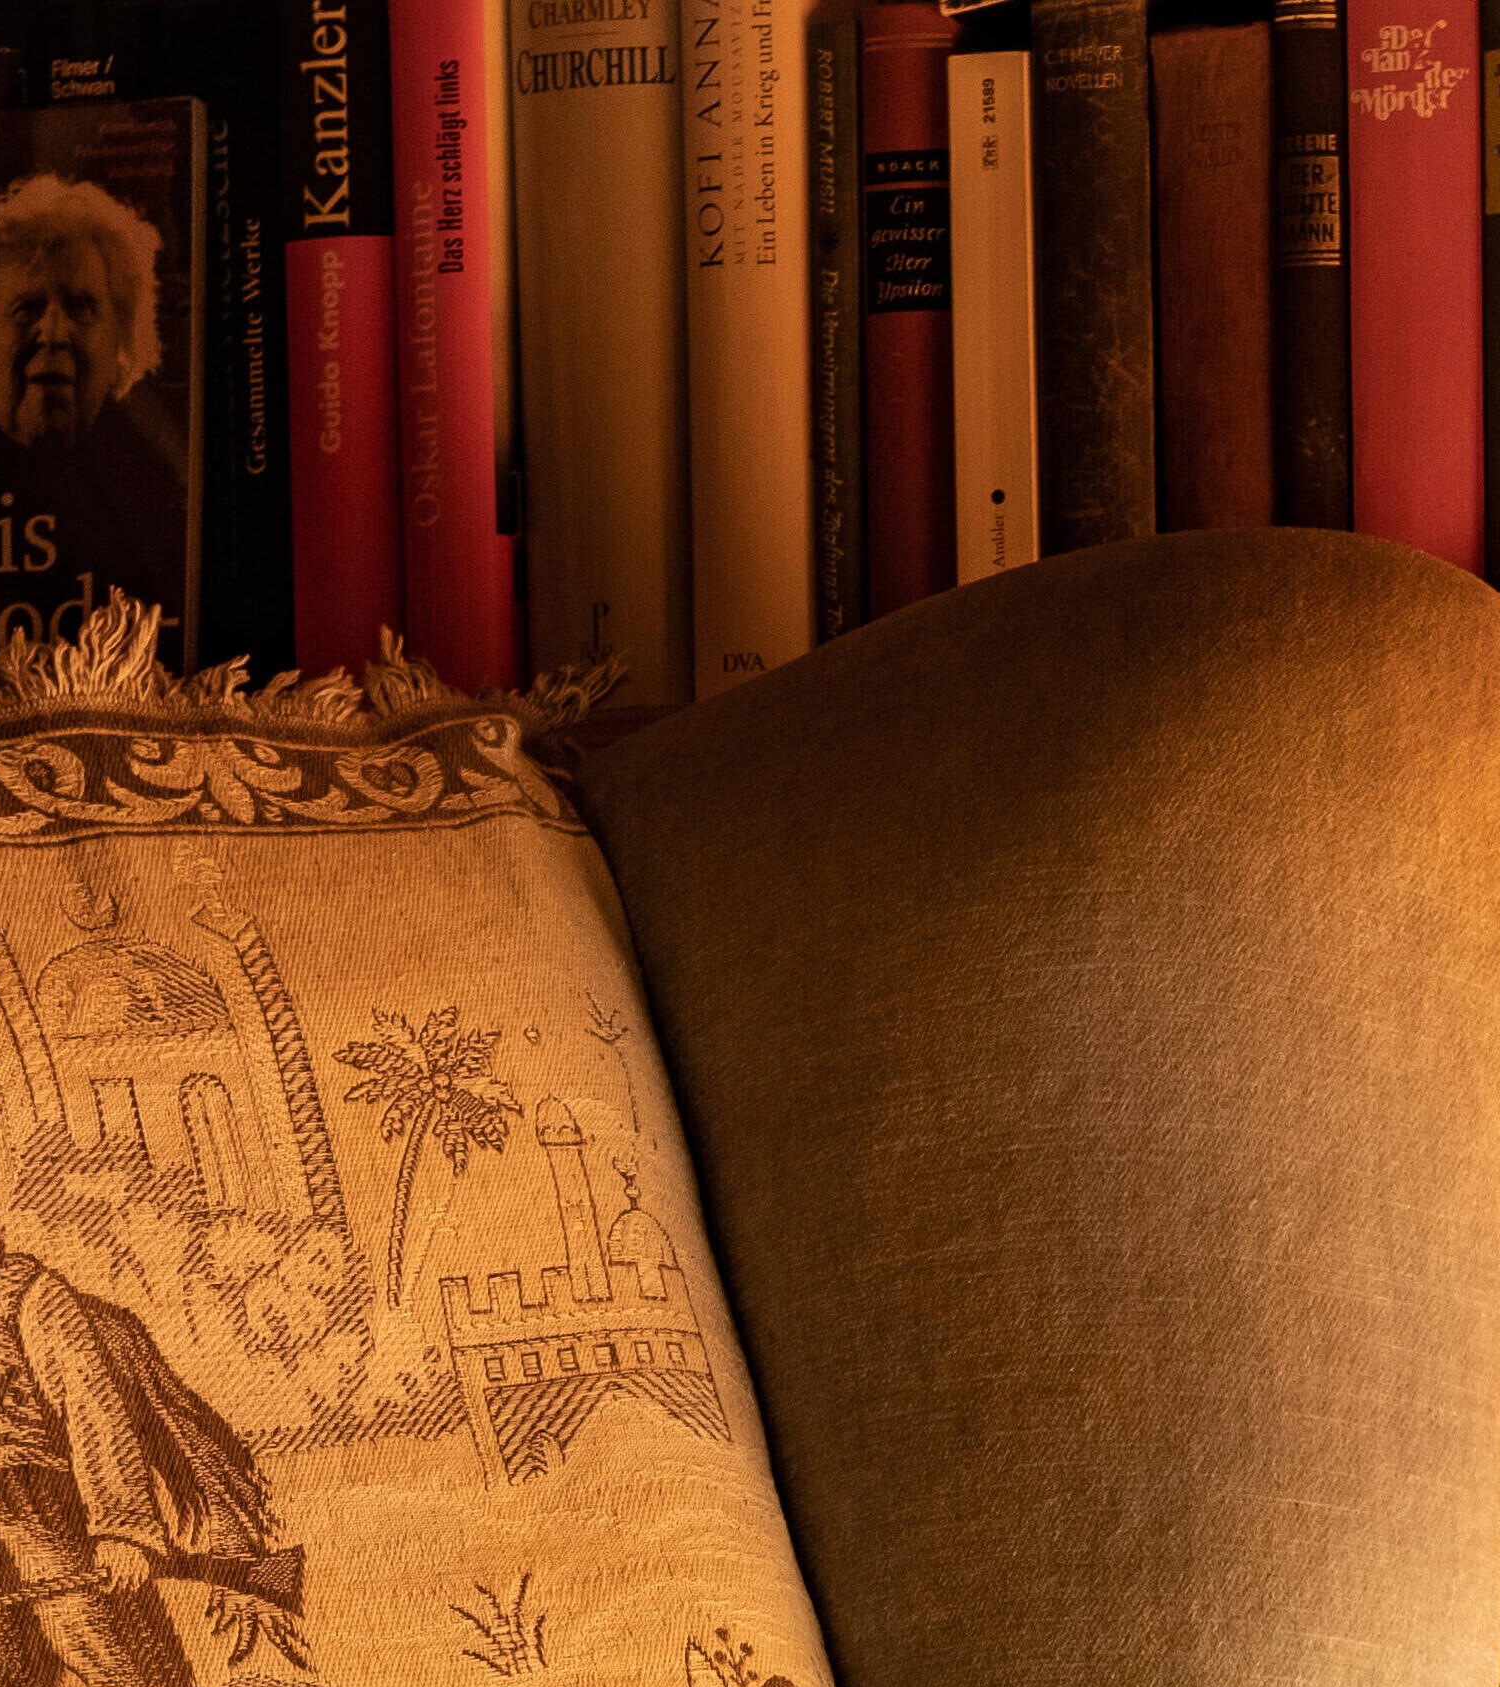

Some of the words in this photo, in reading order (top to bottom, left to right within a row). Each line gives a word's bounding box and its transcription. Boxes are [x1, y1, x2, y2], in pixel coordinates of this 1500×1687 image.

[517, 45, 676, 95] CHURCHILL
[750, 24, 774, 64] und
[50, 79, 116, 102] Schwan
[432, 59, 459, 105] links
[753, 68, 781, 127] Krieg
[981, 78, 997, 124] 21589
[299, 0, 352, 229] Kanzler
[434, 110, 466, 182] schlägt
[755, 135, 774, 155] in
[436, 188, 462, 231] Herz
[696, 152, 724, 269] KOFI
[753, 162, 775, 223] Leben
[240, 216, 264, 301] Werke
[436, 237, 465, 273] Das
[755, 230, 777, 265] Ein
[316, 249, 345, 351] Knopp
[402, 179, 438, 394] Lafontaine
[243, 311, 268, 475] Gesammelte
[318, 360, 342, 452] Guido
[411, 406, 442, 526] Oskar
[991, 513, 1007, 568] Ambler
[722, 651, 765, 673] DVA
